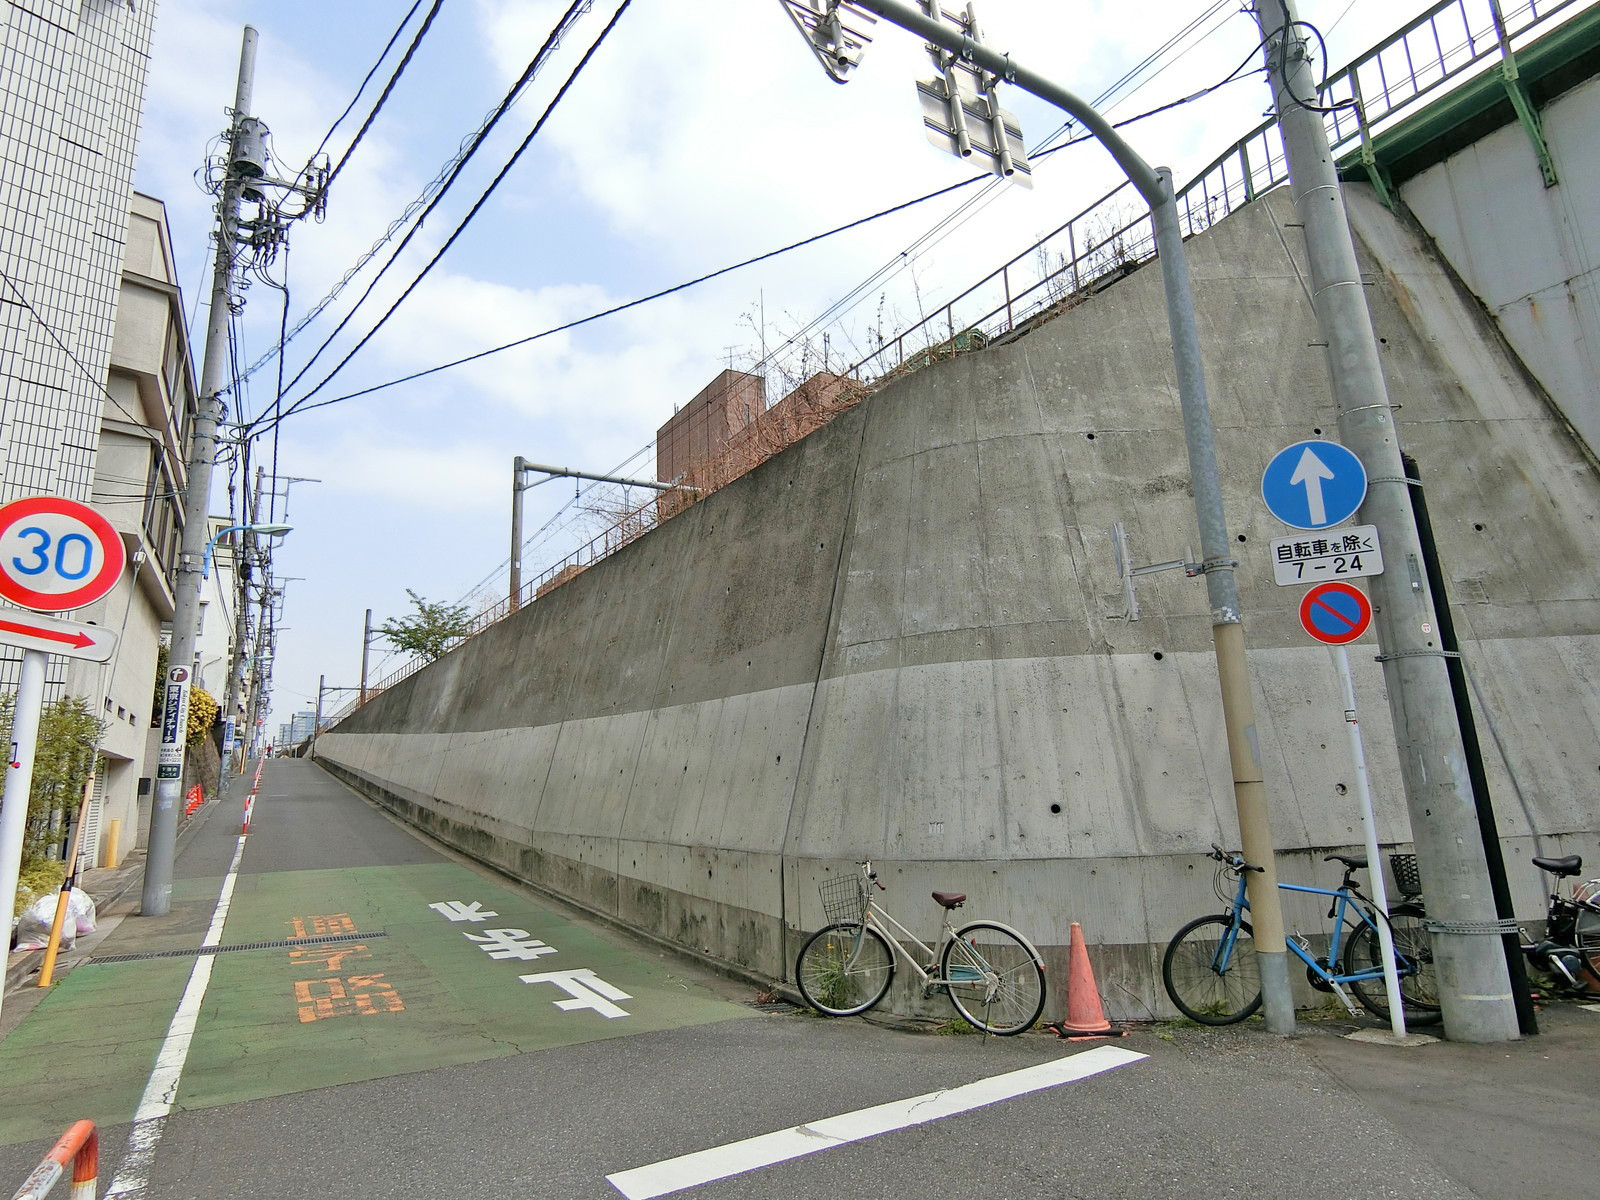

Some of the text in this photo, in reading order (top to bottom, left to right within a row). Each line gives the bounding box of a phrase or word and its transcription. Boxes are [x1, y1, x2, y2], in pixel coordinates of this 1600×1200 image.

[12, 526, 94, 580] 30
[1277, 535, 1373, 560] 自転車を除く
[164, 686, 179, 743] 東京シティチャーチ
